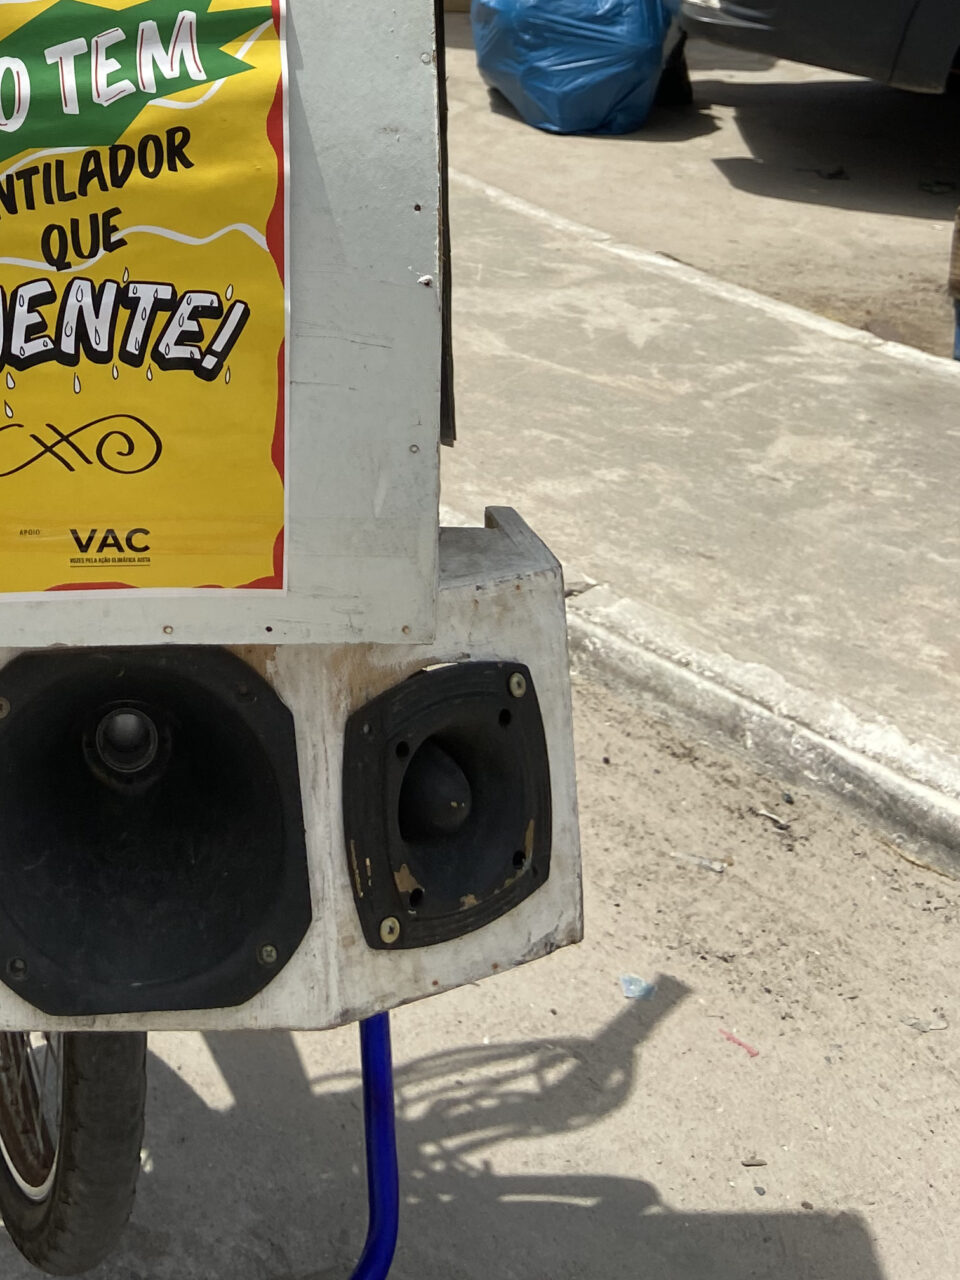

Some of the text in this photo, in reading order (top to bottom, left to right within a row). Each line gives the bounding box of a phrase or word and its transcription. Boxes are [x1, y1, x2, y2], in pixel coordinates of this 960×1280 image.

[46, 10, 208, 115] TEM
[41, 207, 129, 273] QUE
[19, 528, 41, 536] APOIO
[70, 528, 151, 553] VAC
